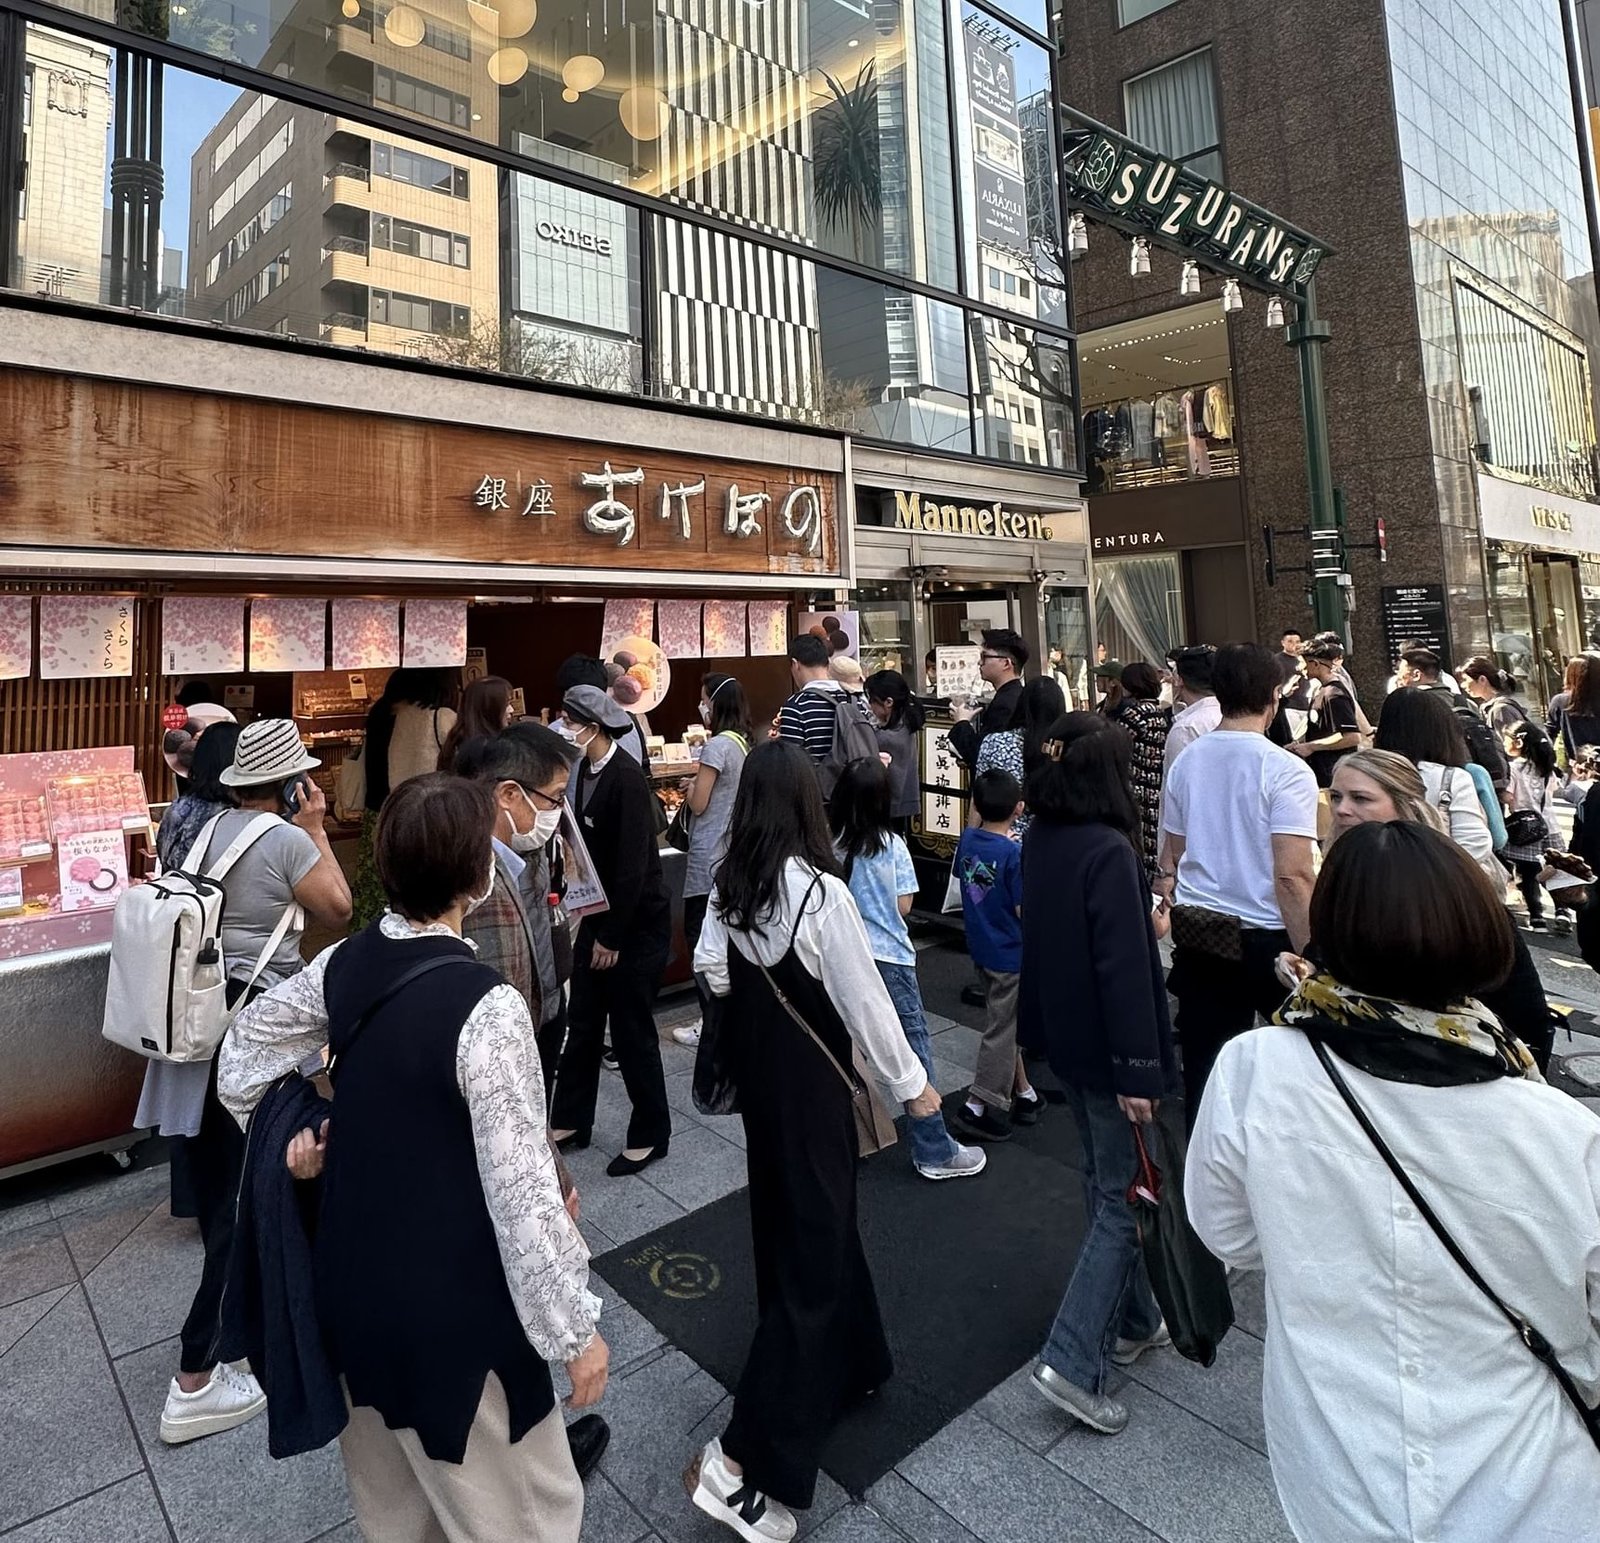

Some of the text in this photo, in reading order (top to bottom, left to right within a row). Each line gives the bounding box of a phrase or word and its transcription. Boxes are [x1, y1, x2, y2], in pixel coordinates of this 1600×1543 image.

[1111, 160, 1285, 266] SUZURAN
[475, 460, 822, 553] 銀座 あけぼの
[894, 490, 1045, 540] Manneken
[103, 629, 114, 669] さくら
[118, 606, 128, 646] さくら
